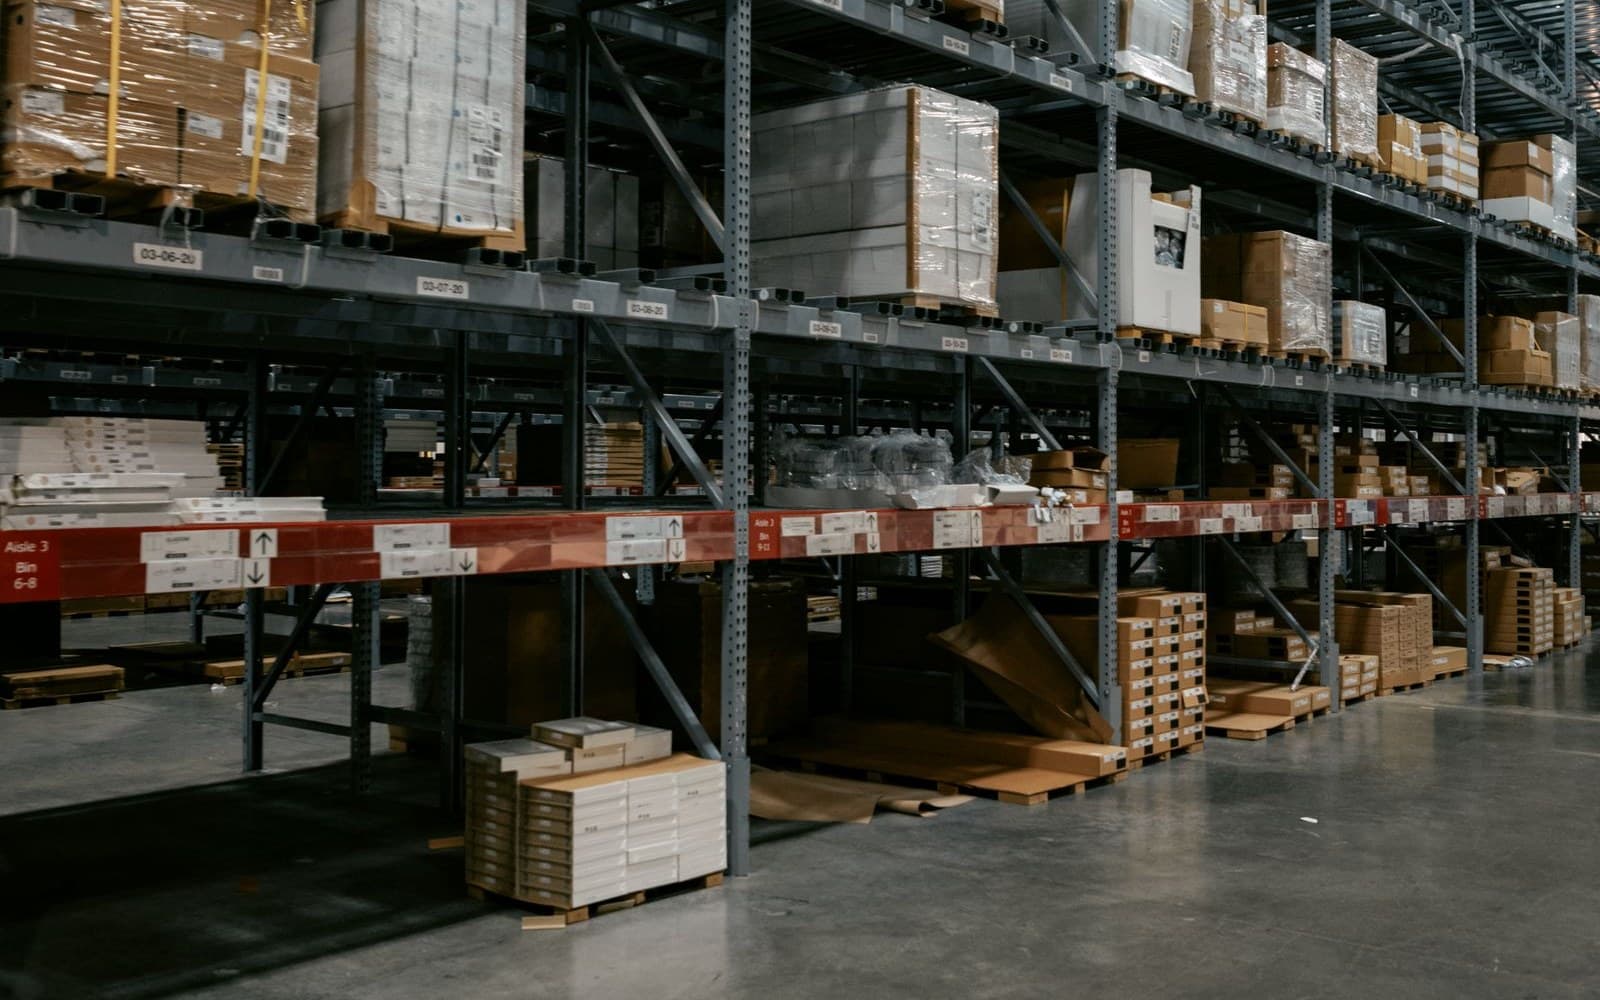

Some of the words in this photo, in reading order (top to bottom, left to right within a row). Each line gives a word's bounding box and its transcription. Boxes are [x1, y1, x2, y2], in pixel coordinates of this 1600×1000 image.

[140, 248, 196, 265] 03-06-20
[422, 281, 464, 294] 03-07-20
[4, 541, 37, 553] Aisle
[40, 540, 49, 552] 3
[15, 561, 37, 574] Bin
[13, 577, 38, 590] 6-8
